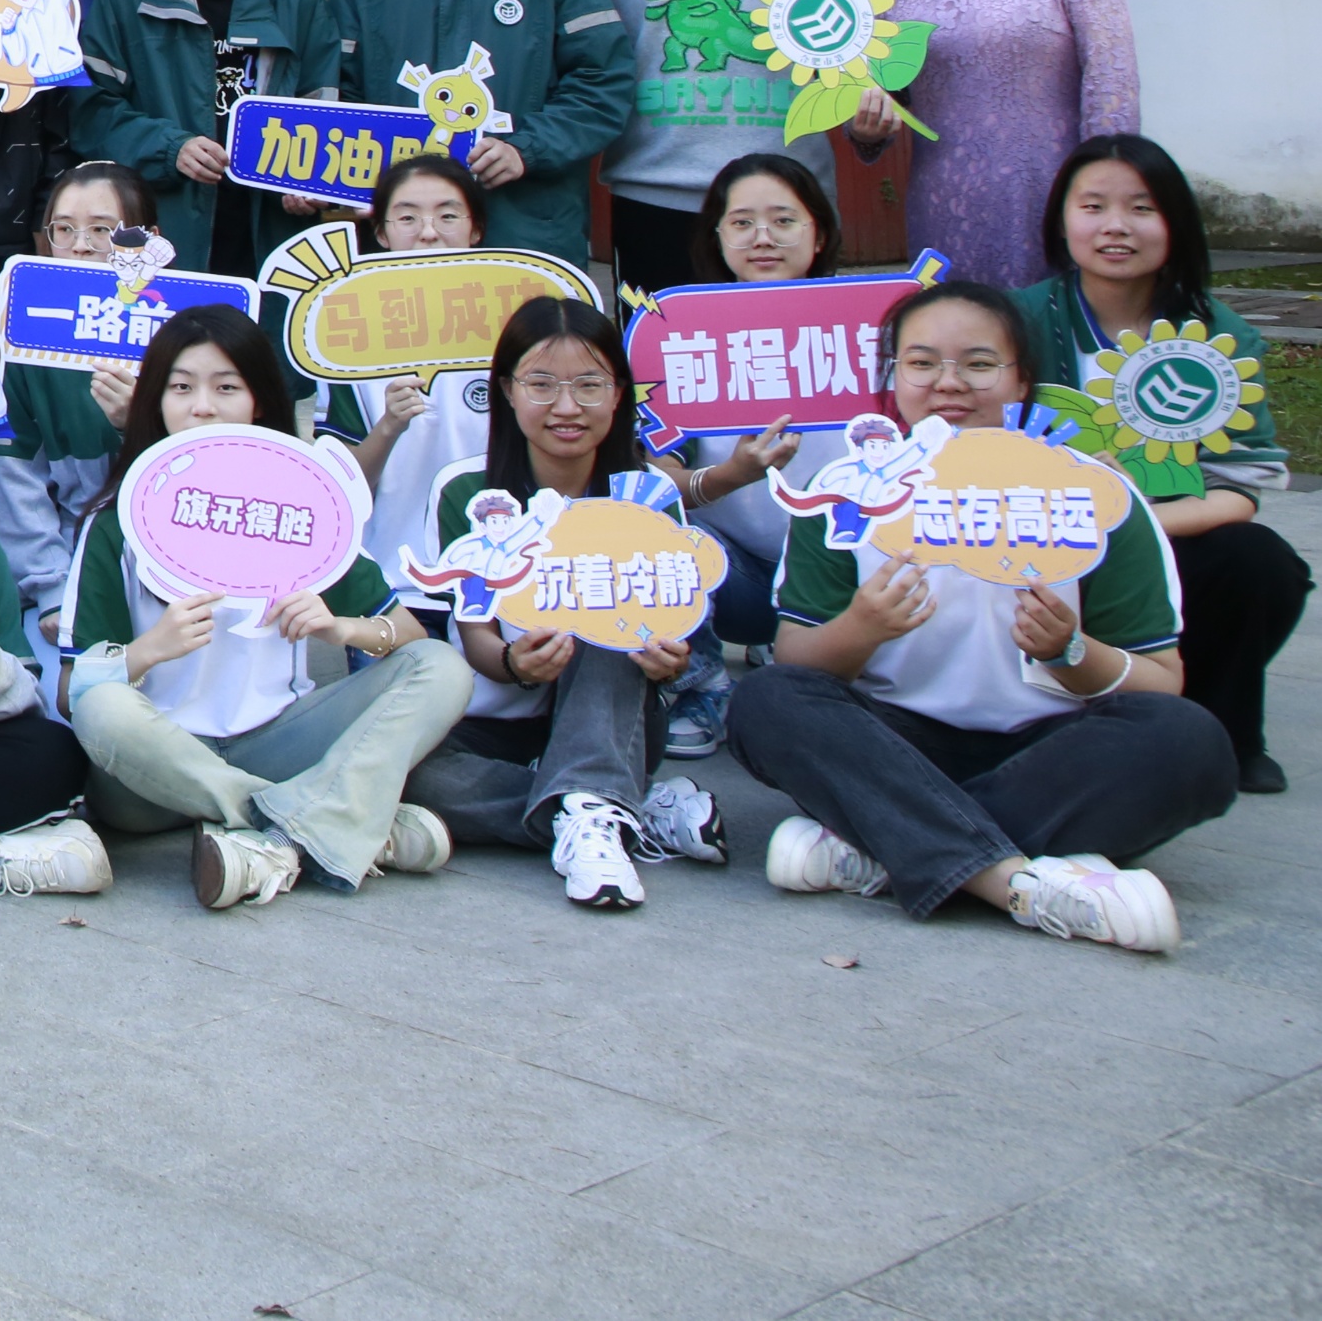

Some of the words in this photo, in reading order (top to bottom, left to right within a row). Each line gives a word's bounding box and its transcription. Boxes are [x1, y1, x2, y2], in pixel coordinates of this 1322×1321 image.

[26, 295, 177, 347] 一路前
[171, 486, 315, 546] 旗开得胜
[912, 485, 1099, 550] 志存高远
[534, 551, 700, 612] 沉着冷静
